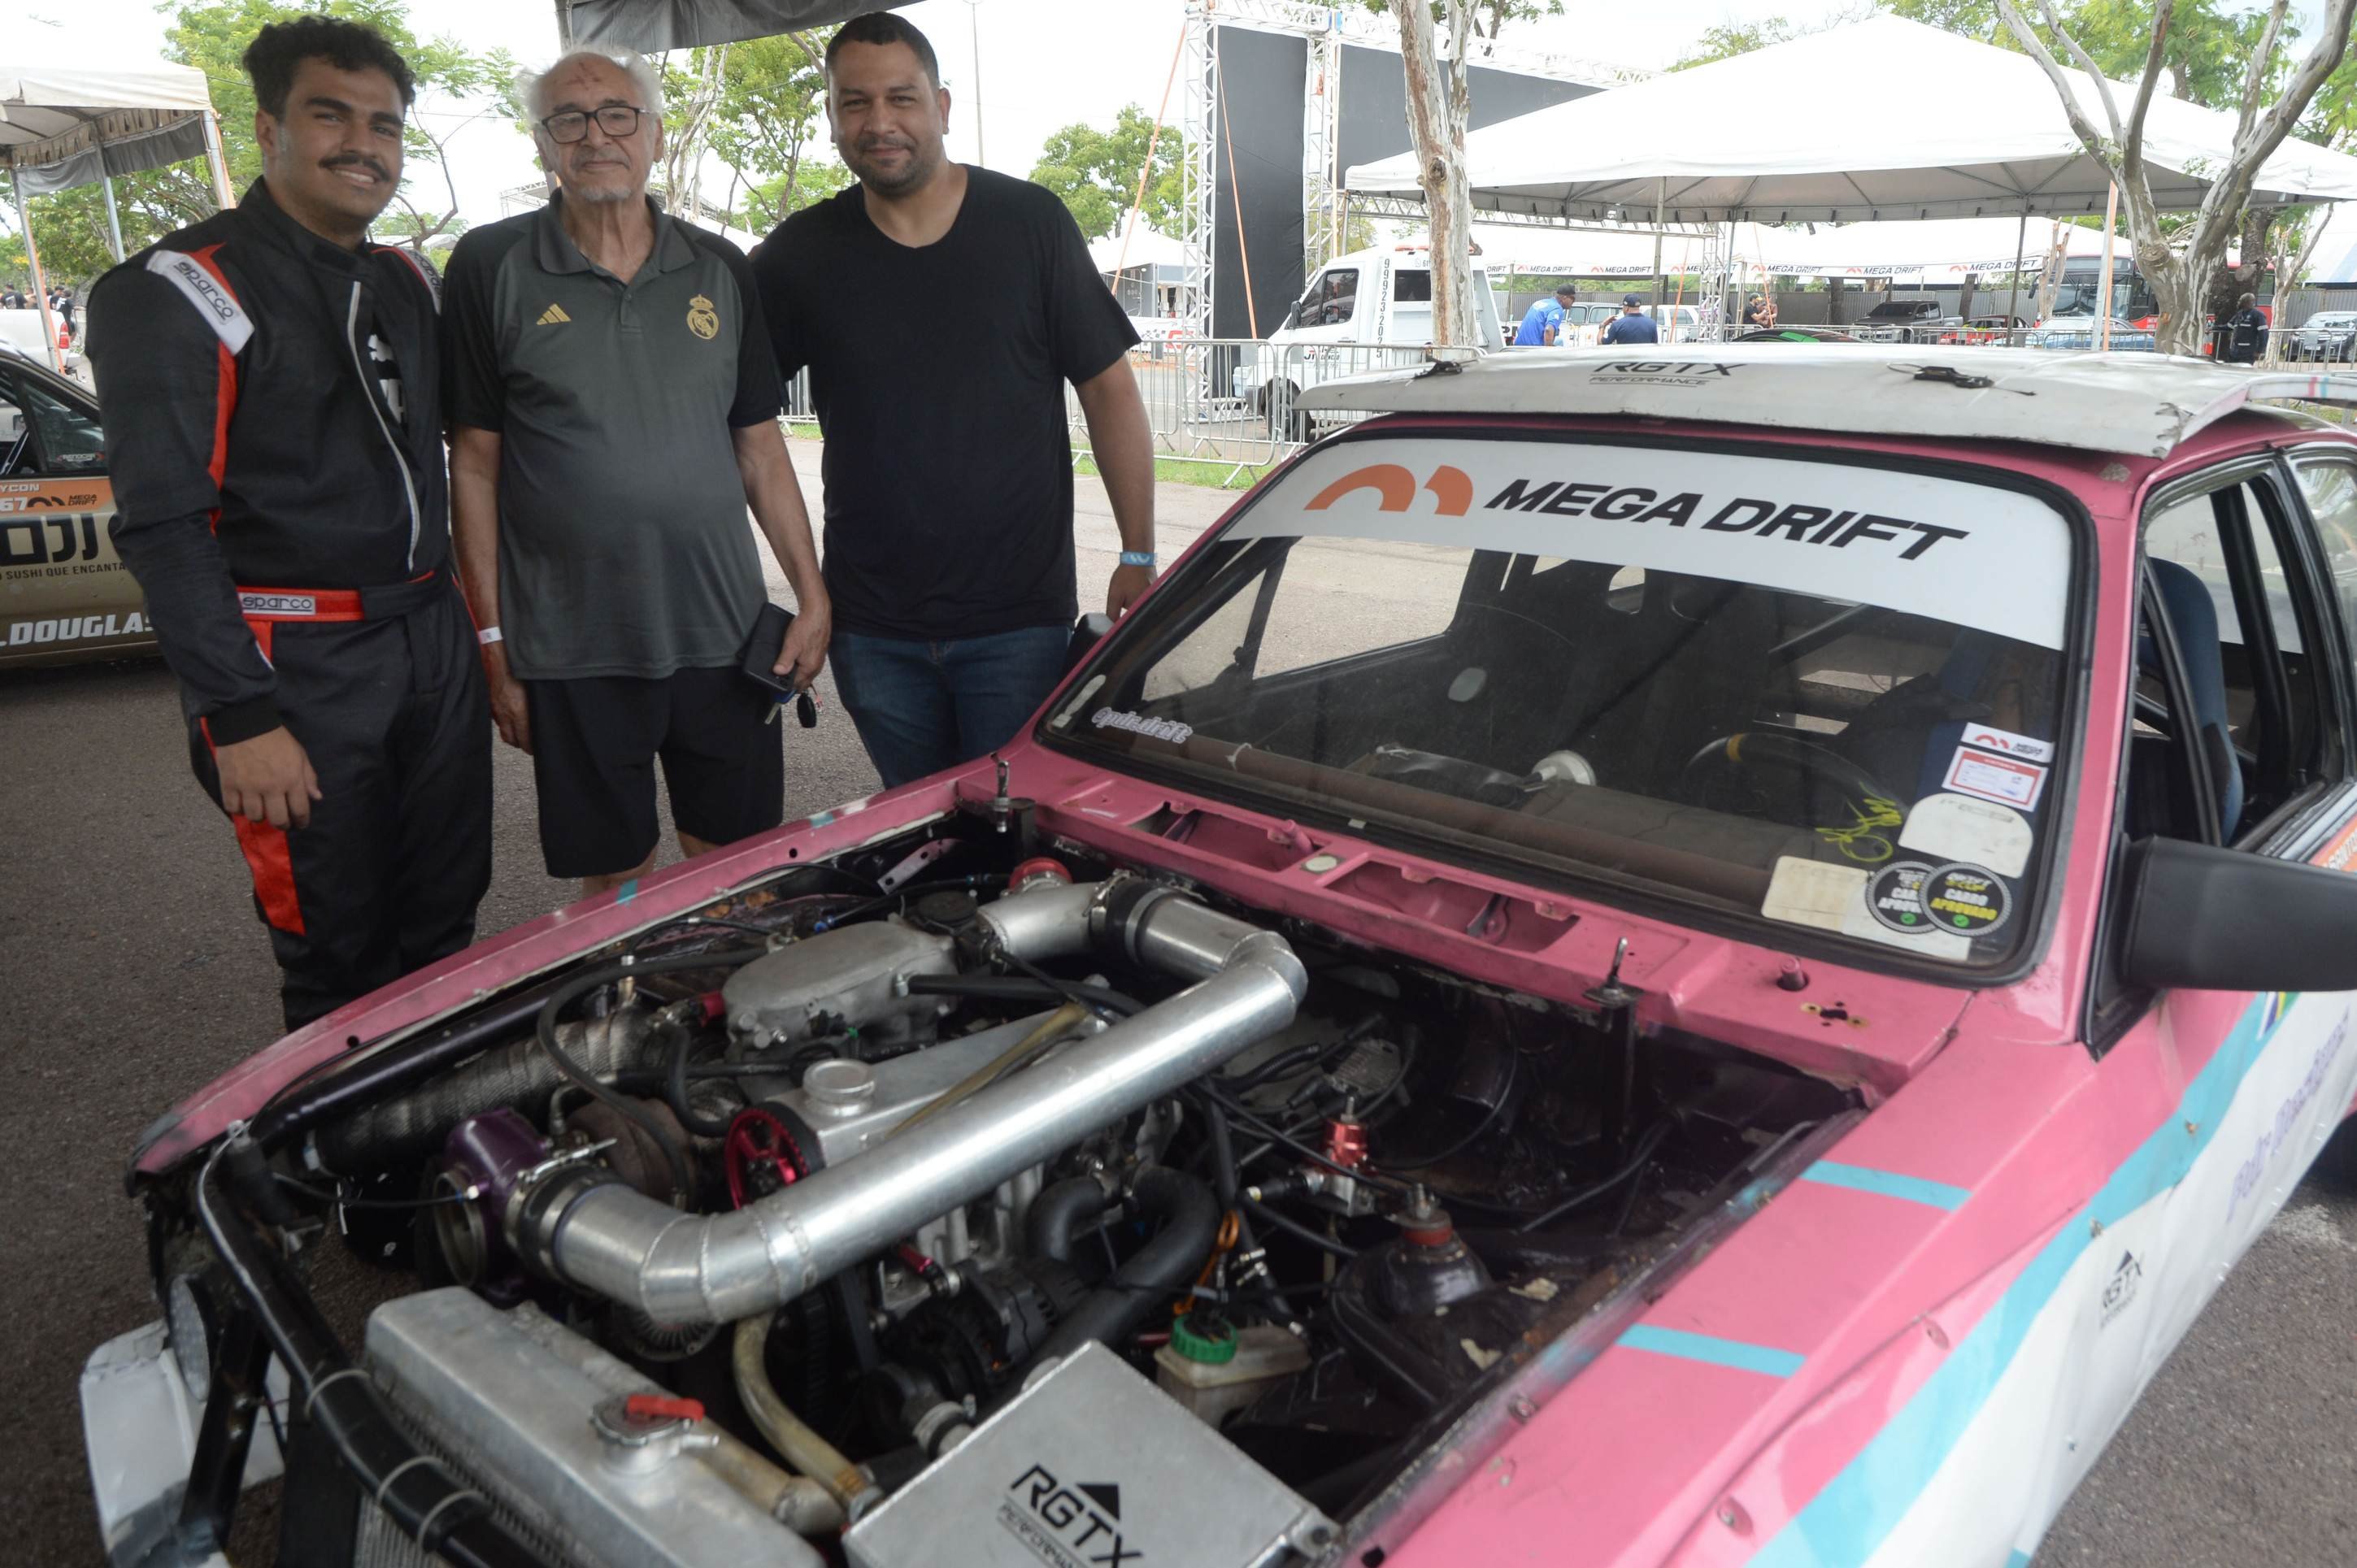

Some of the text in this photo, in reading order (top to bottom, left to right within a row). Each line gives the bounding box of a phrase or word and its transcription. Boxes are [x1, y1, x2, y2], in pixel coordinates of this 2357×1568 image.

[1767, 265, 1794, 273] MEGA
[1863, 266, 1924, 275] MEGA DRIFT
[1969, 263, 2002, 271] MEGA
[177, 261, 234, 318] sparco
[1593, 361, 1747, 376] RGTX
[1589, 376, 1710, 386] PERFORMANCE
[1483, 478, 1971, 561] MEGA DRIFT
[7, 567, 43, 580] SUSHI
[46, 567, 71, 577] QUE
[73, 562, 125, 575] ENCANTA
[242, 596, 312, 610] sparco
[1010, 1461, 1143, 1568] RGTX
